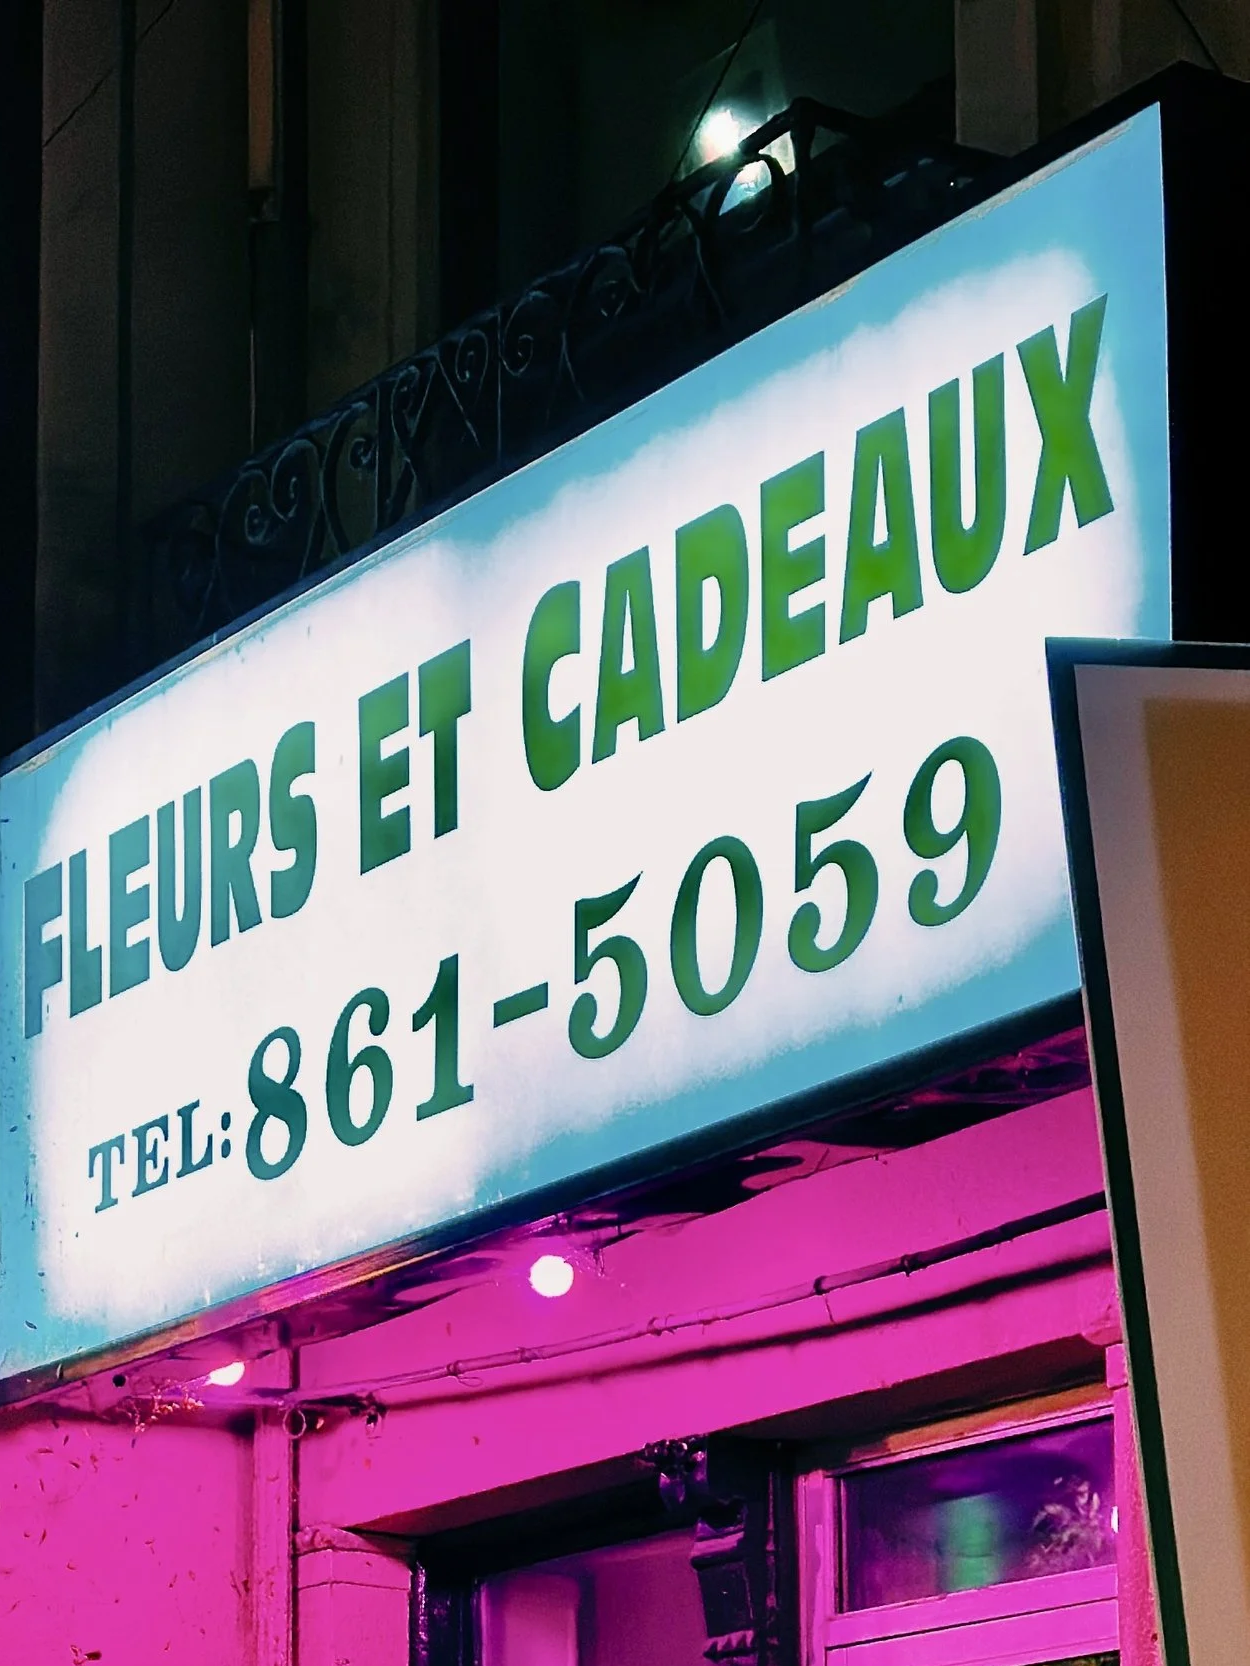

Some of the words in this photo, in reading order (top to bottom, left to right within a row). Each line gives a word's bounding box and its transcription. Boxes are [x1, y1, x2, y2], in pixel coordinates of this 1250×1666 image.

[23, 722, 317, 1041] FLEURS
[358, 639, 471, 875] ET
[522, 293, 1114, 791] CADEAUX
[88, 1098, 233, 1213] TEL:
[246, 736, 1001, 1180] 861-5059
